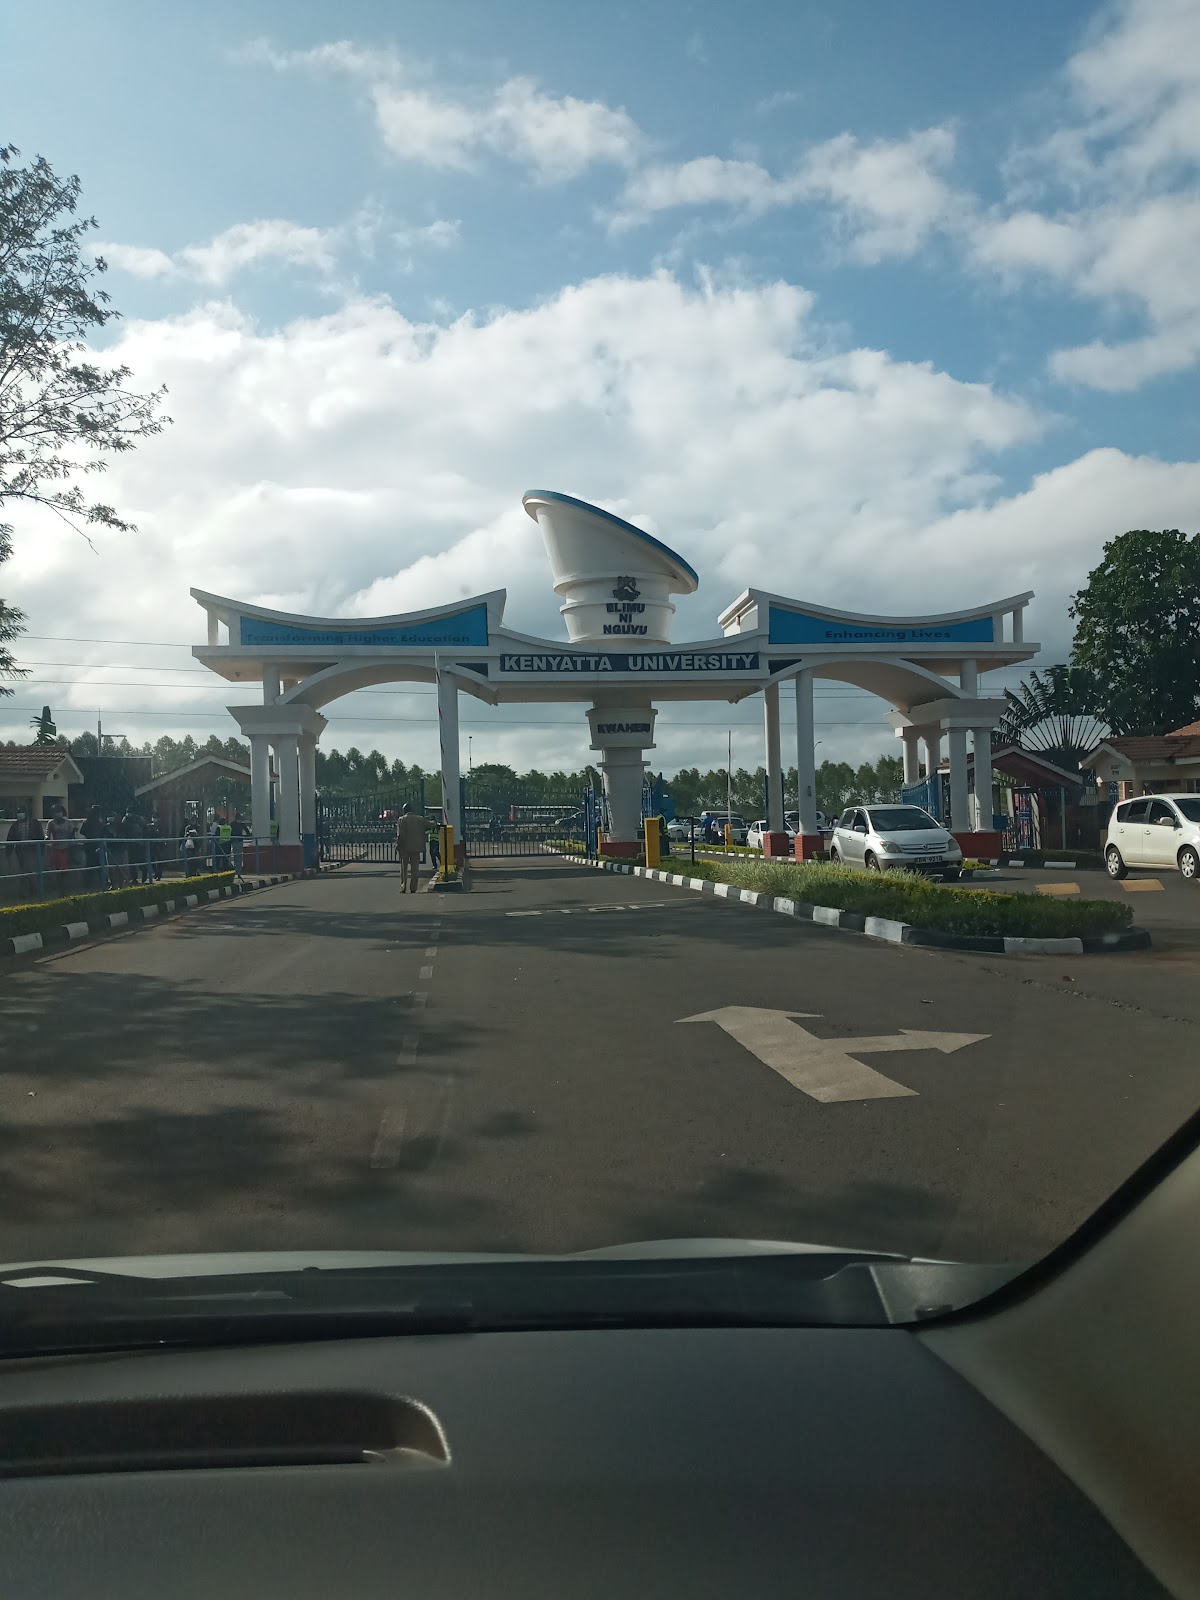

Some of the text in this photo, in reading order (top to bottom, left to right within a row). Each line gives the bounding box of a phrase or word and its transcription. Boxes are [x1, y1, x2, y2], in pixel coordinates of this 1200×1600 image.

[605, 602, 645, 613] ELIMU
[619, 613, 632, 623] NI
[603, 624, 648, 635] NGUVU
[347, 634, 396, 644] Higher
[401, 634, 470, 643] Education
[825, 630, 951, 640] Enhancing Lives
[504, 654, 755, 671] KENYATTA UNIVERSITY
